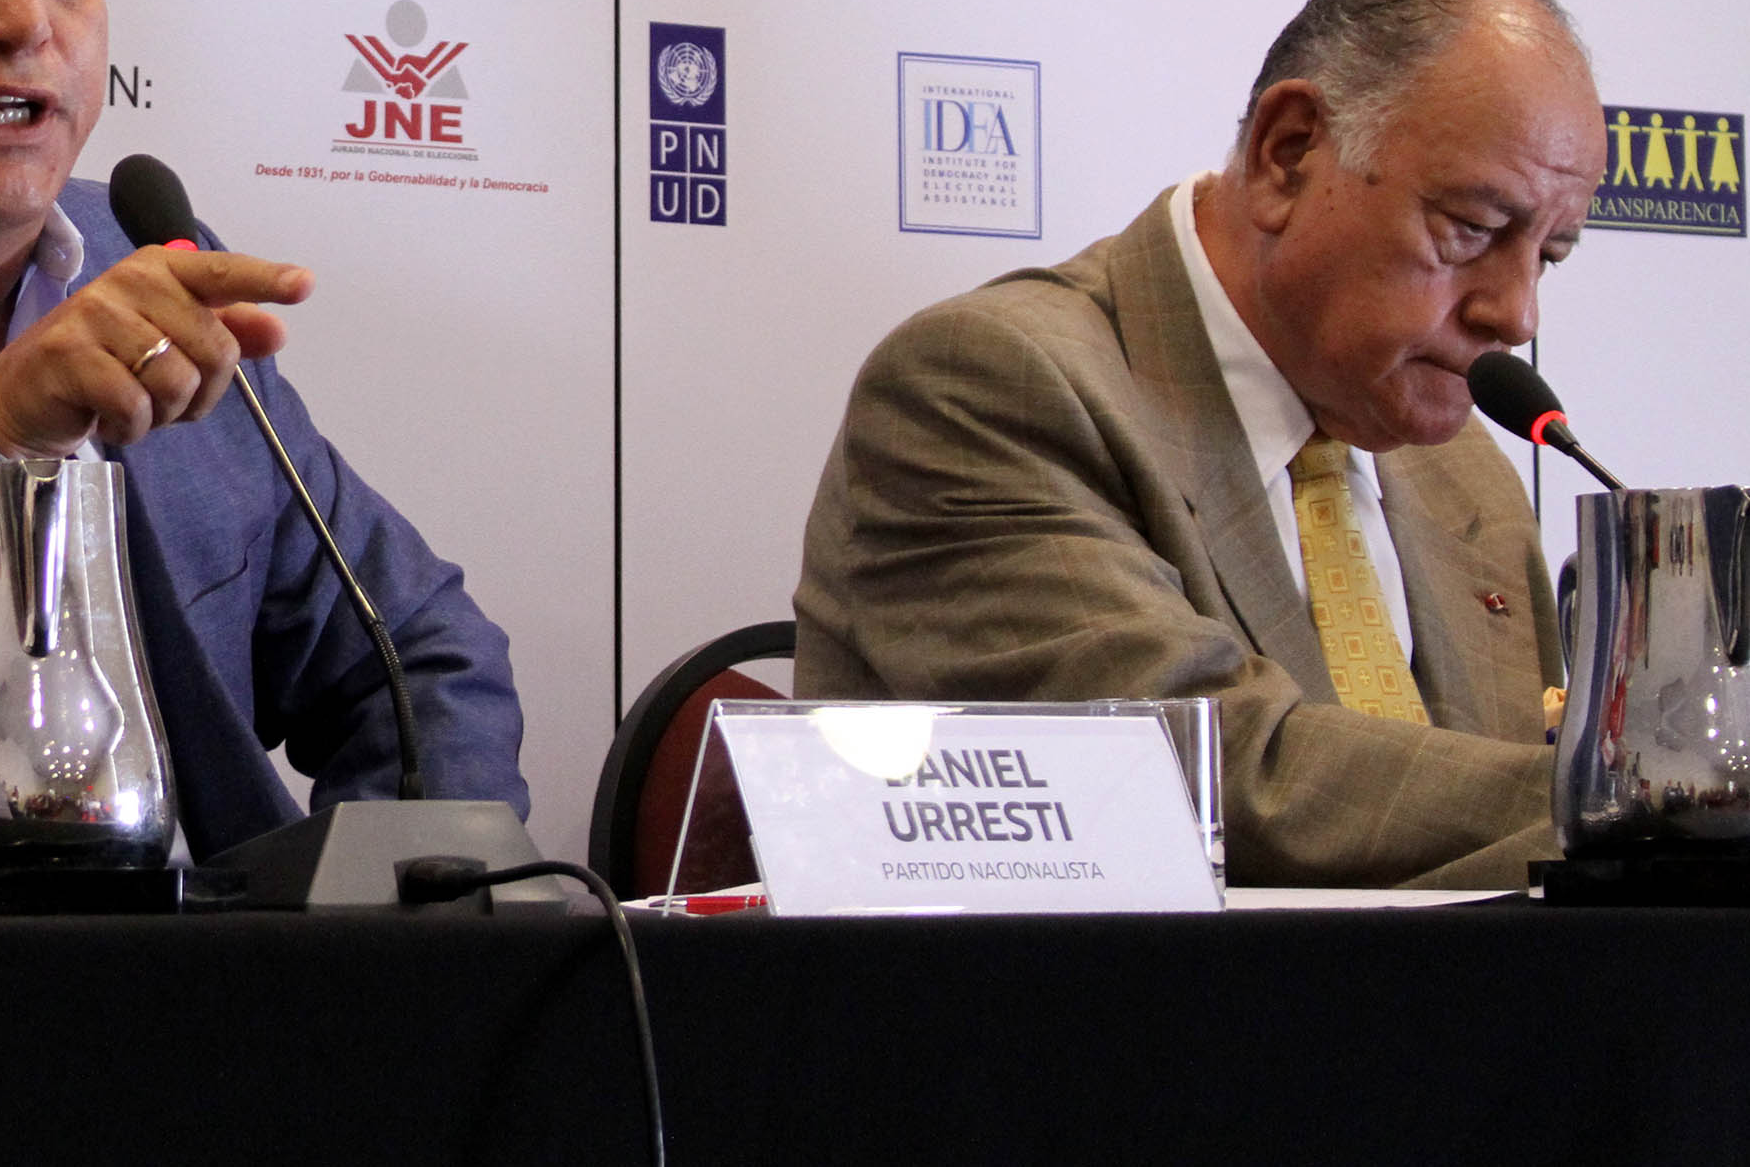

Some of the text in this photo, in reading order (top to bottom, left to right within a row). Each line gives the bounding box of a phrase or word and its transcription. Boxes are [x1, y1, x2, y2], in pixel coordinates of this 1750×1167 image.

[922, 86, 1015, 99] INTERNATIONAL
[345, 100, 464, 144] JNE
[920, 98, 1020, 156] IDEA
[330, 145, 366, 155] JURADO
[368, 147, 411, 158] NACIONAL
[426, 151, 479, 162] ELECCIONES
[922, 156, 1017, 169] INSTITUTE FOR
[255, 163, 549, 193] Desde 1931, por la Gobernabilidad y la Democracia
[923, 169, 1017, 182] DEMOCRACY AND
[923, 181, 1016, 194] ELECTORAL
[923, 194, 1017, 207] ASSISTANCE
[1590, 196, 1740, 225] RANSPARENCIA
[882, 801, 1074, 843] URRESTI
[881, 861, 1106, 881] PARTIDO NACIONALISTA
